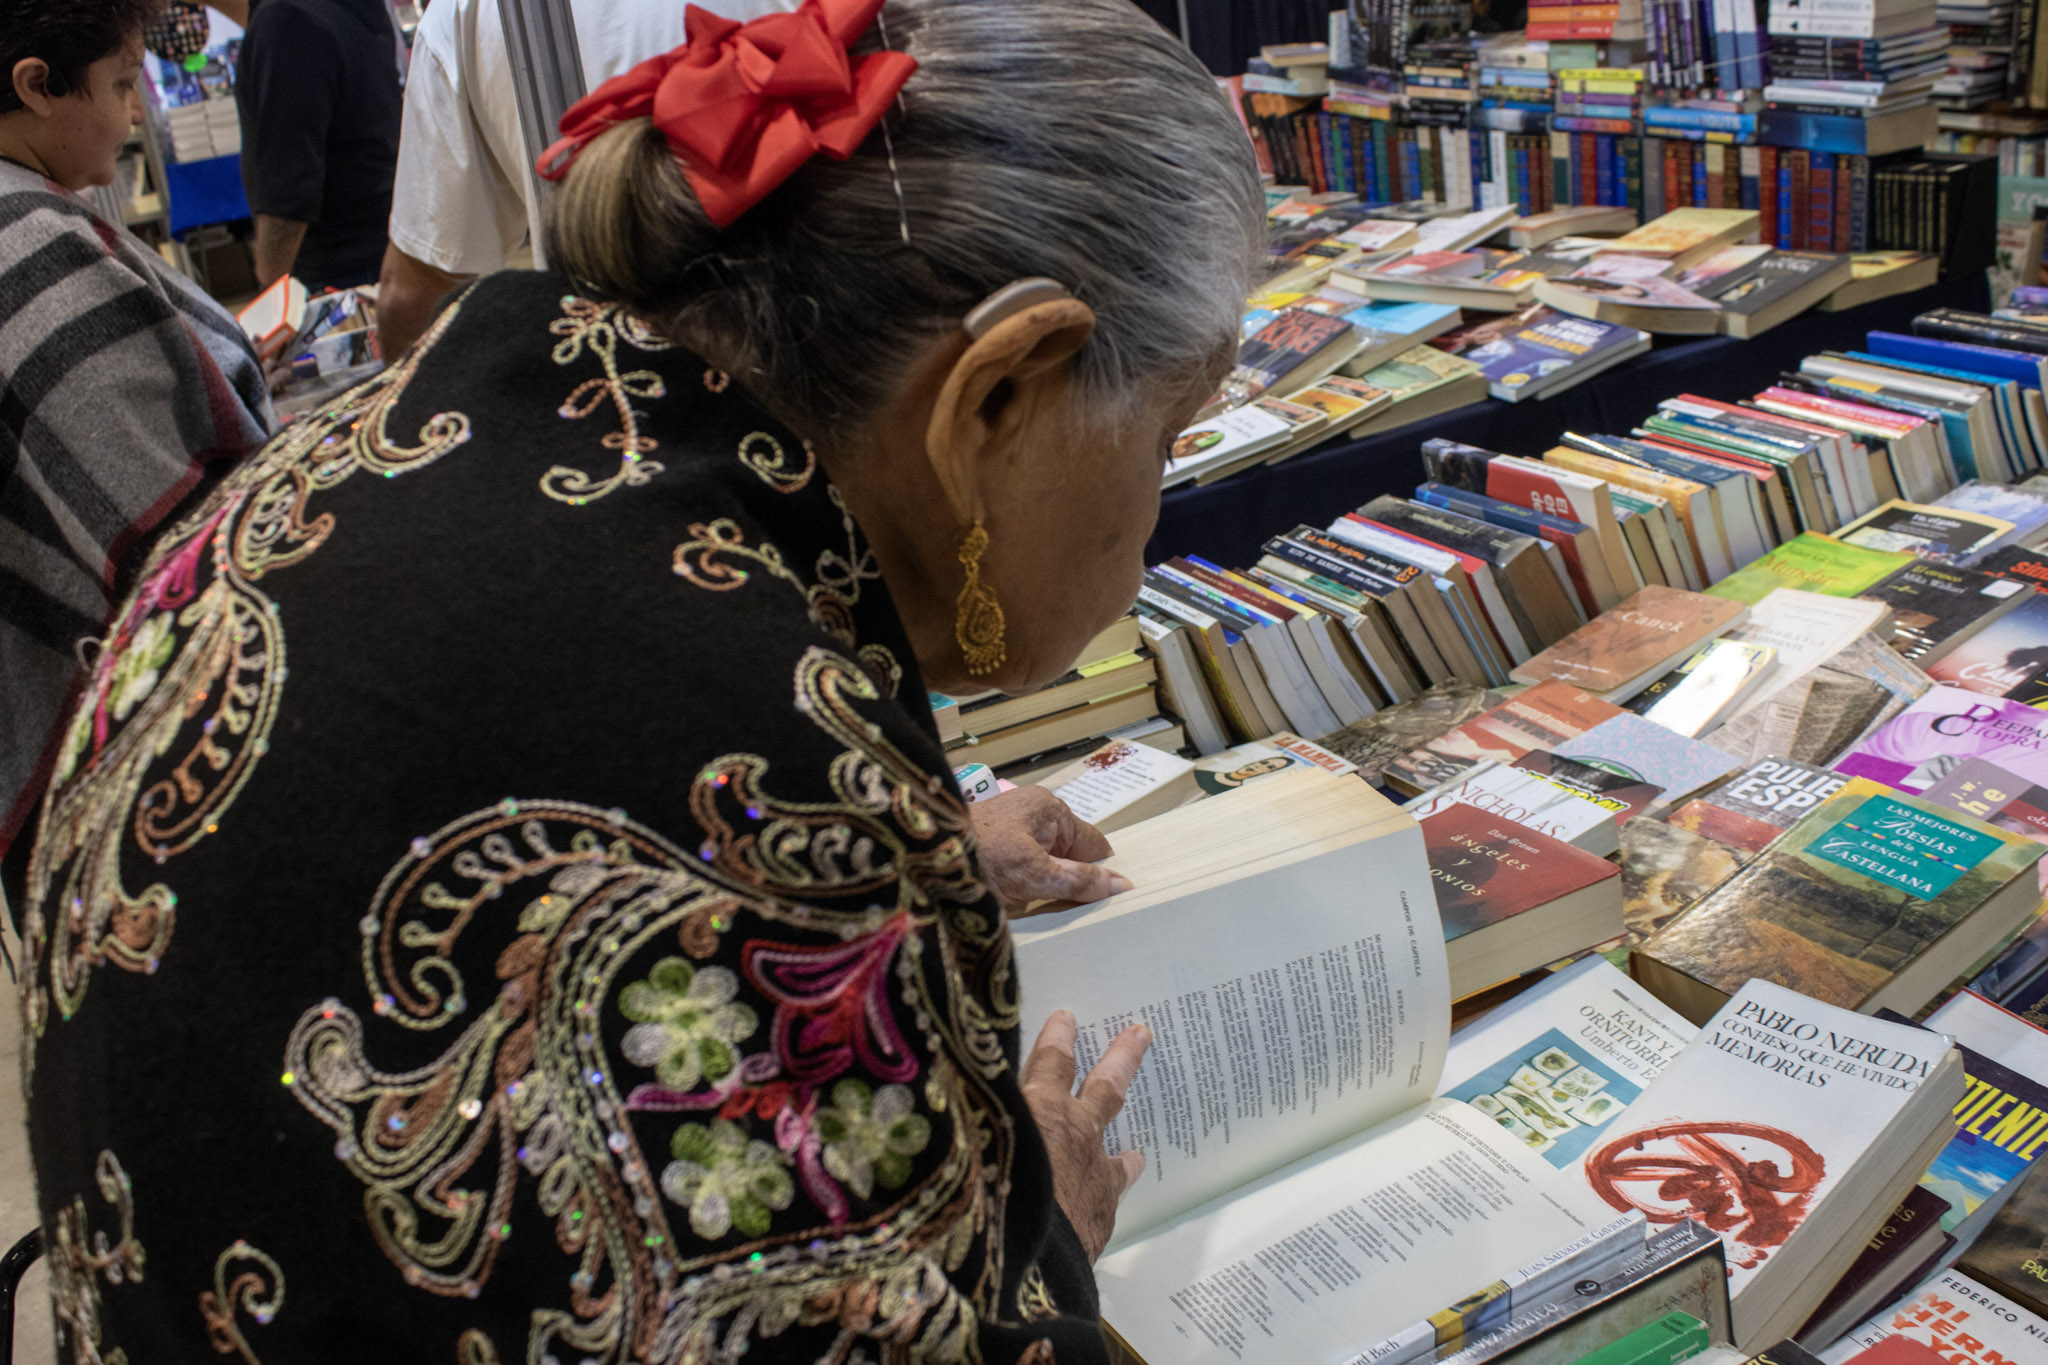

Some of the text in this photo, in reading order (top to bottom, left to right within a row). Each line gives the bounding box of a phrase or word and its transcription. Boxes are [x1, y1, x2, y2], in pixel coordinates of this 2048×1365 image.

[1622, 611, 1687, 633] Canek
[1930, 714, 2041, 749] CHOPRA
[1458, 782, 1566, 839] NICHOLAS
[1726, 777, 1822, 820] ESP
[1486, 828, 1541, 855] Dan Brown
[1886, 804, 1979, 843] LAS MEJORES
[1821, 836, 1933, 894] CASTELLANA
[1860, 840, 1919, 868] LENGUA
[1580, 1005, 1669, 1071] ORNITORRI
[1580, 1025, 1639, 1070] Umberto
[1611, 1009, 1674, 1052] KANT Y
[1734, 1000, 1819, 1041] PABLO
[1817, 1031, 1930, 1078] NERUDA
[1705, 1031, 1831, 1088] MEMORIAS
[1722, 1018, 1920, 1092] CONFIESO QUE HE VIVIDO
[1518, 1261, 1545, 1278] JUAN
[1544, 1235, 1593, 1265] SALVADOR
[1920, 1292, 1971, 1325] MI
[1941, 1277, 2019, 1323] FEDERICO
[1368, 1339, 1400, 1360] Bach
